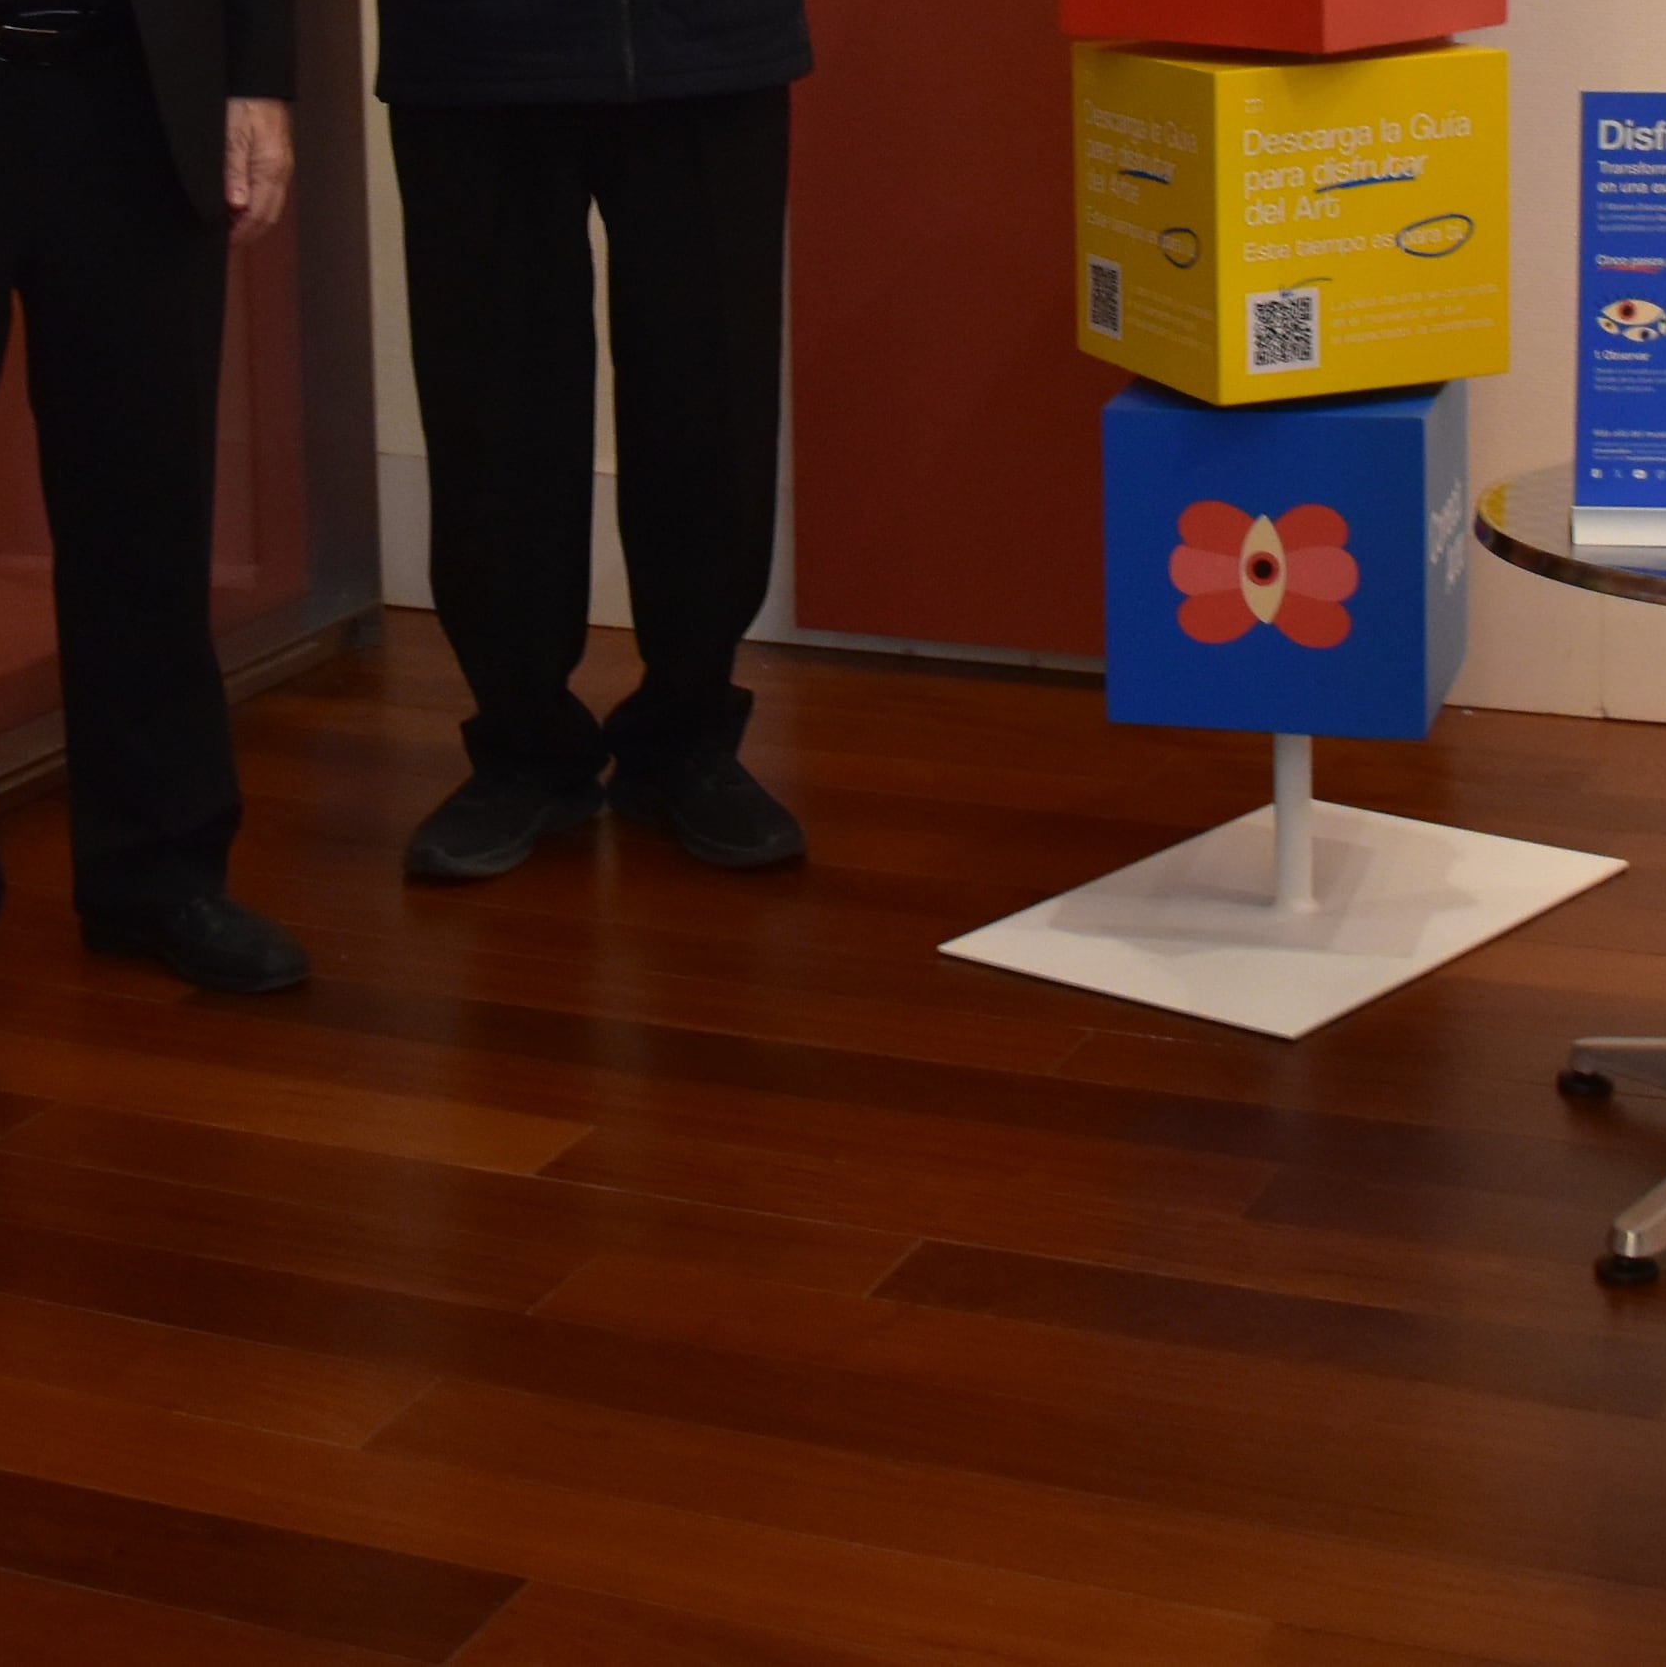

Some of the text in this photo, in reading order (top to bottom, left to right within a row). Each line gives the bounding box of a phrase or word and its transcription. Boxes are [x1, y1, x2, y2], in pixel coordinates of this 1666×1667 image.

[1243, 111, 1471, 156] Descarga la Guía
[1244, 154, 1429, 200] para disfrutar
[1597, 182, 1617, 194] en
[1619, 182, 1648, 194] una
[1244, 198, 1285, 226] del
[1243, 242, 1291, 262] Este
[1296, 235, 1366, 257] tiempo
[1371, 232, 1396, 249] es
